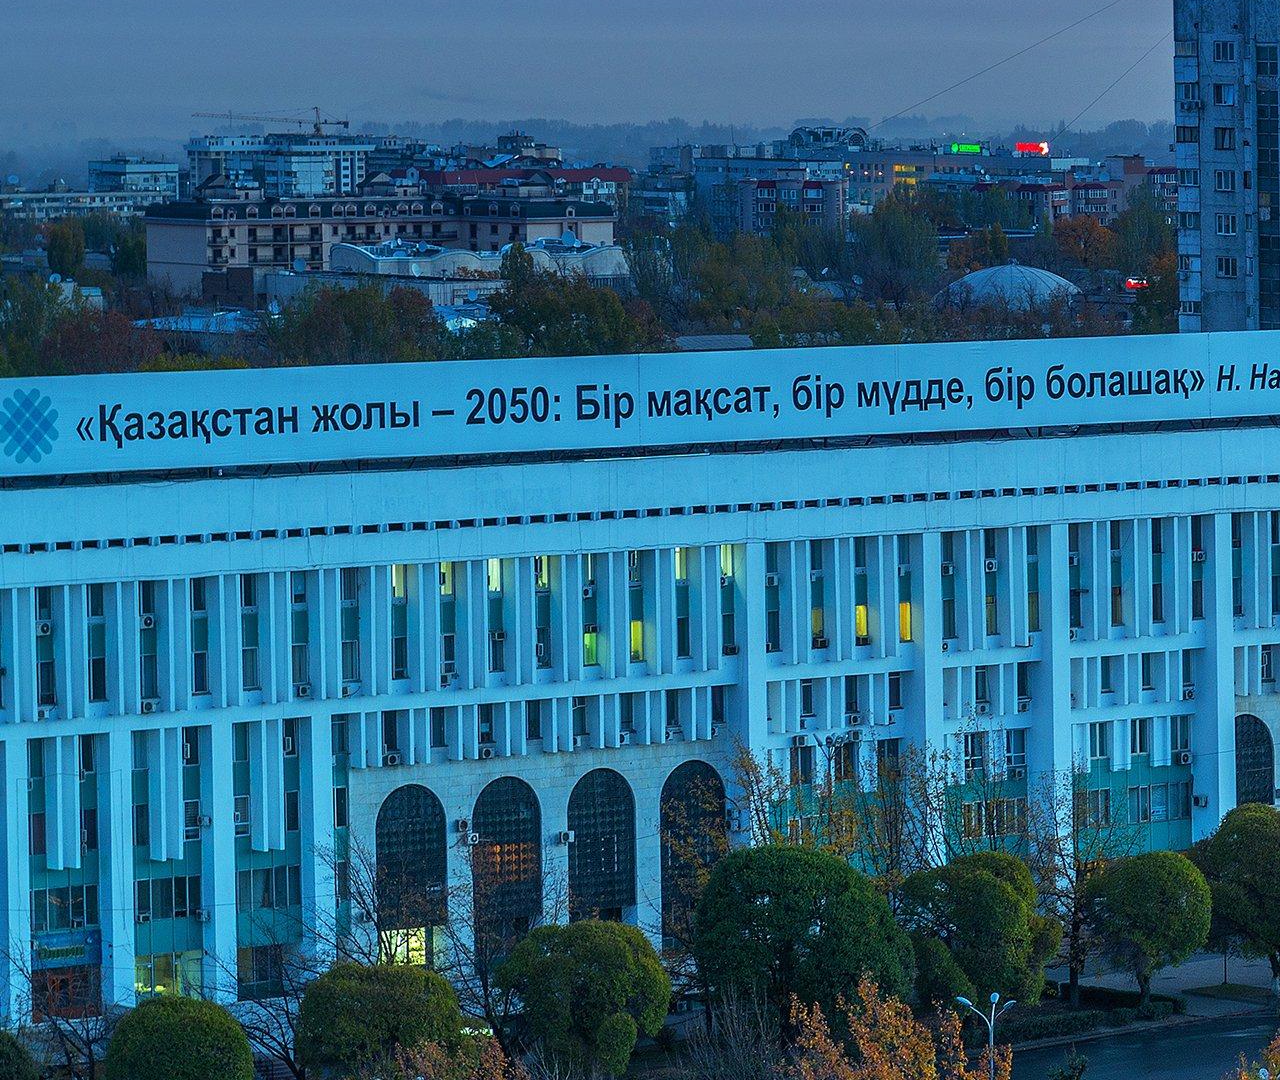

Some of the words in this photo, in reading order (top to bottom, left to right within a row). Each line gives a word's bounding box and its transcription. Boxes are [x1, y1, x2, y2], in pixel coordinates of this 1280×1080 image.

[75, 400, 299, 450] «Қазақстан
[311, 400, 420, 433] жолы
[466, 385, 561, 426] 2050:
[575, 383, 635, 429] Бір
[647, 385, 780, 422] мақсат,
[792, 374, 845, 419] бір
[857, 376, 973, 416] мүдде,
[984, 366, 1035, 410] бір
[1045, 363, 1206, 400] болашақ»
[1216, 364, 1242, 393] Н.
